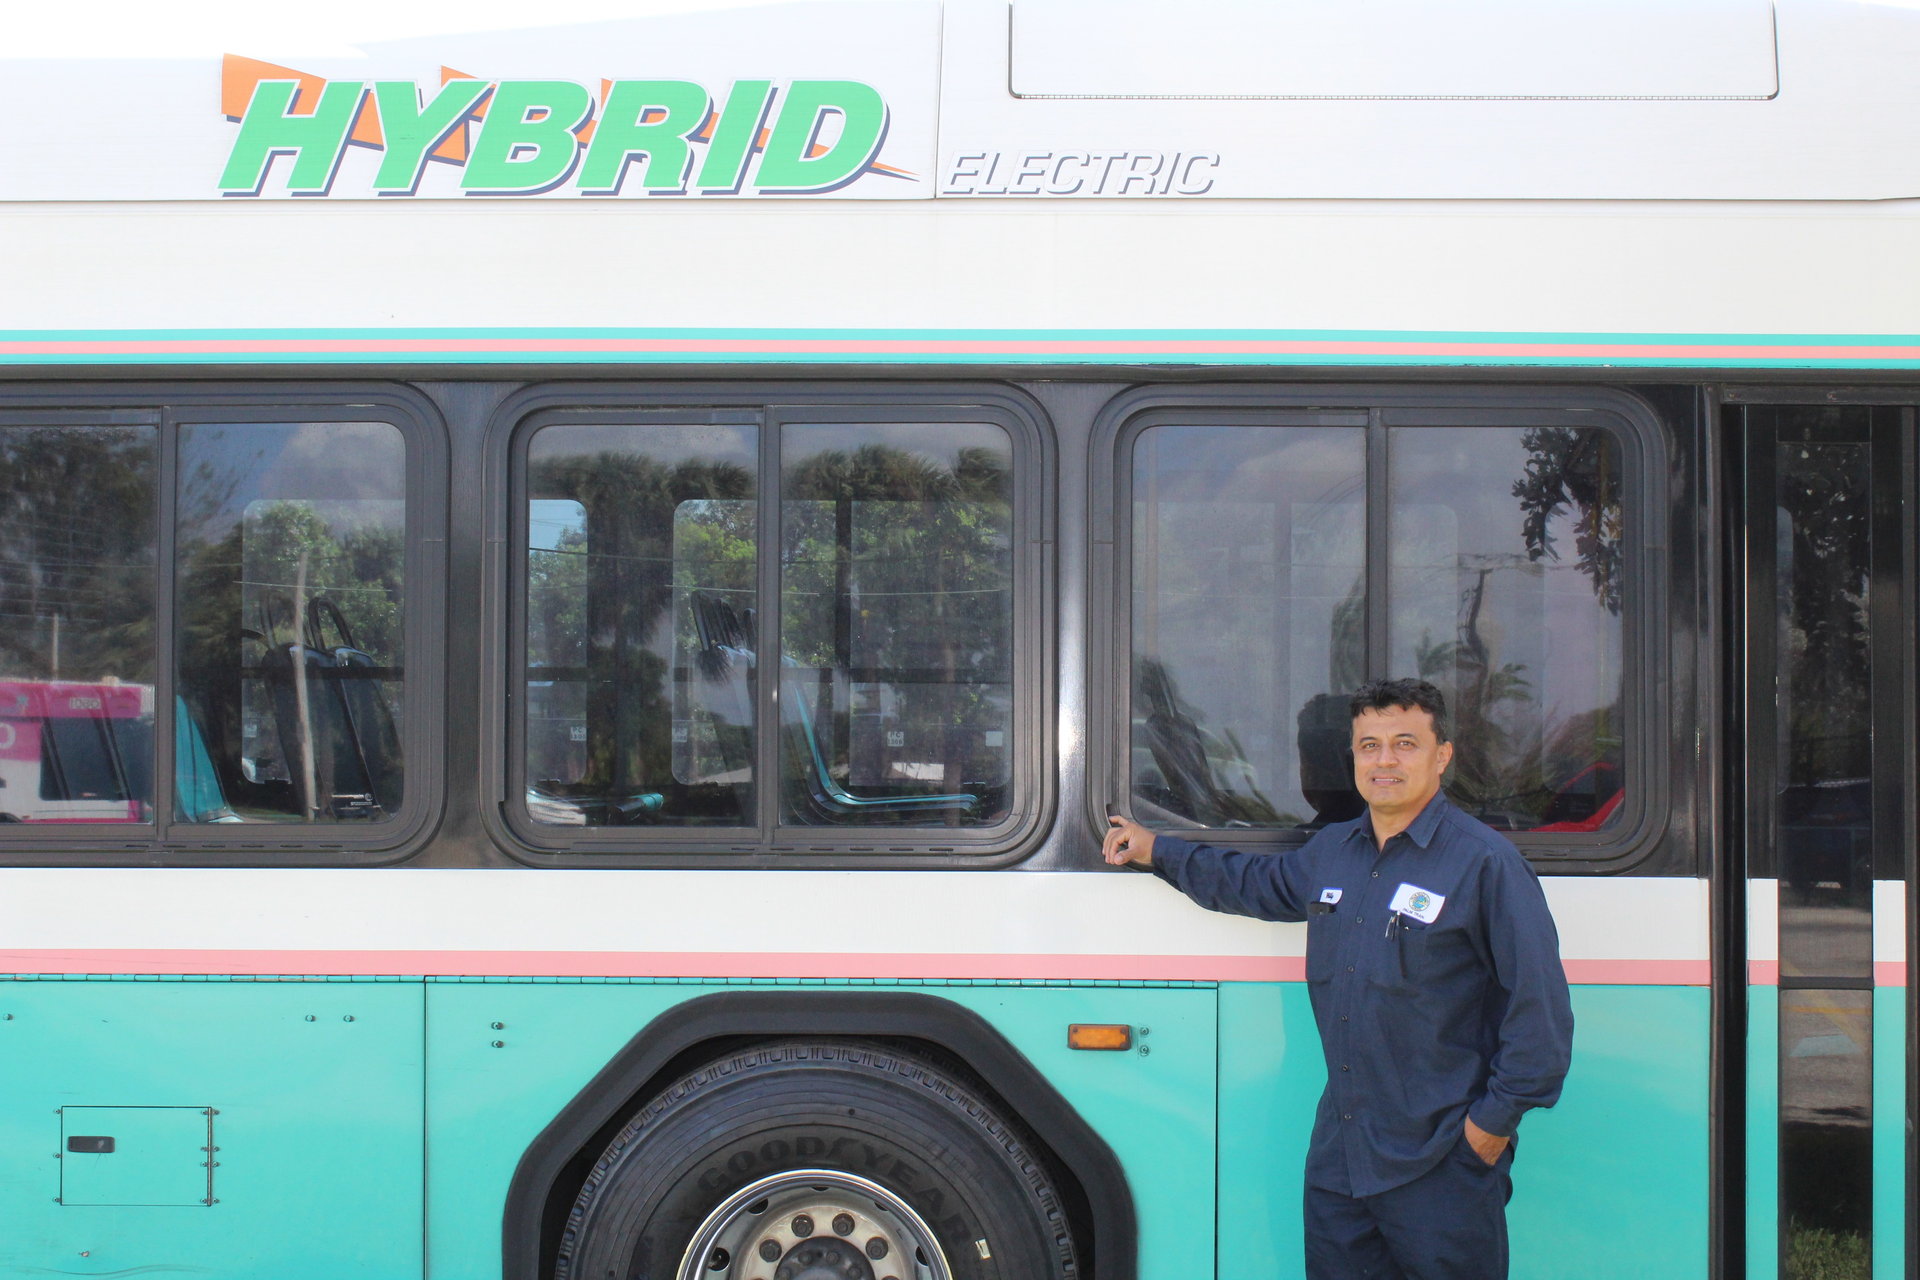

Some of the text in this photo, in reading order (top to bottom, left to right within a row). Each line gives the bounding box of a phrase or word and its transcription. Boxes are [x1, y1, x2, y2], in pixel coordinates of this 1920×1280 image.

[217, 77, 1220, 197] HYBRID ELECTRIC
[699, 1135, 974, 1246] GOODYEAR
